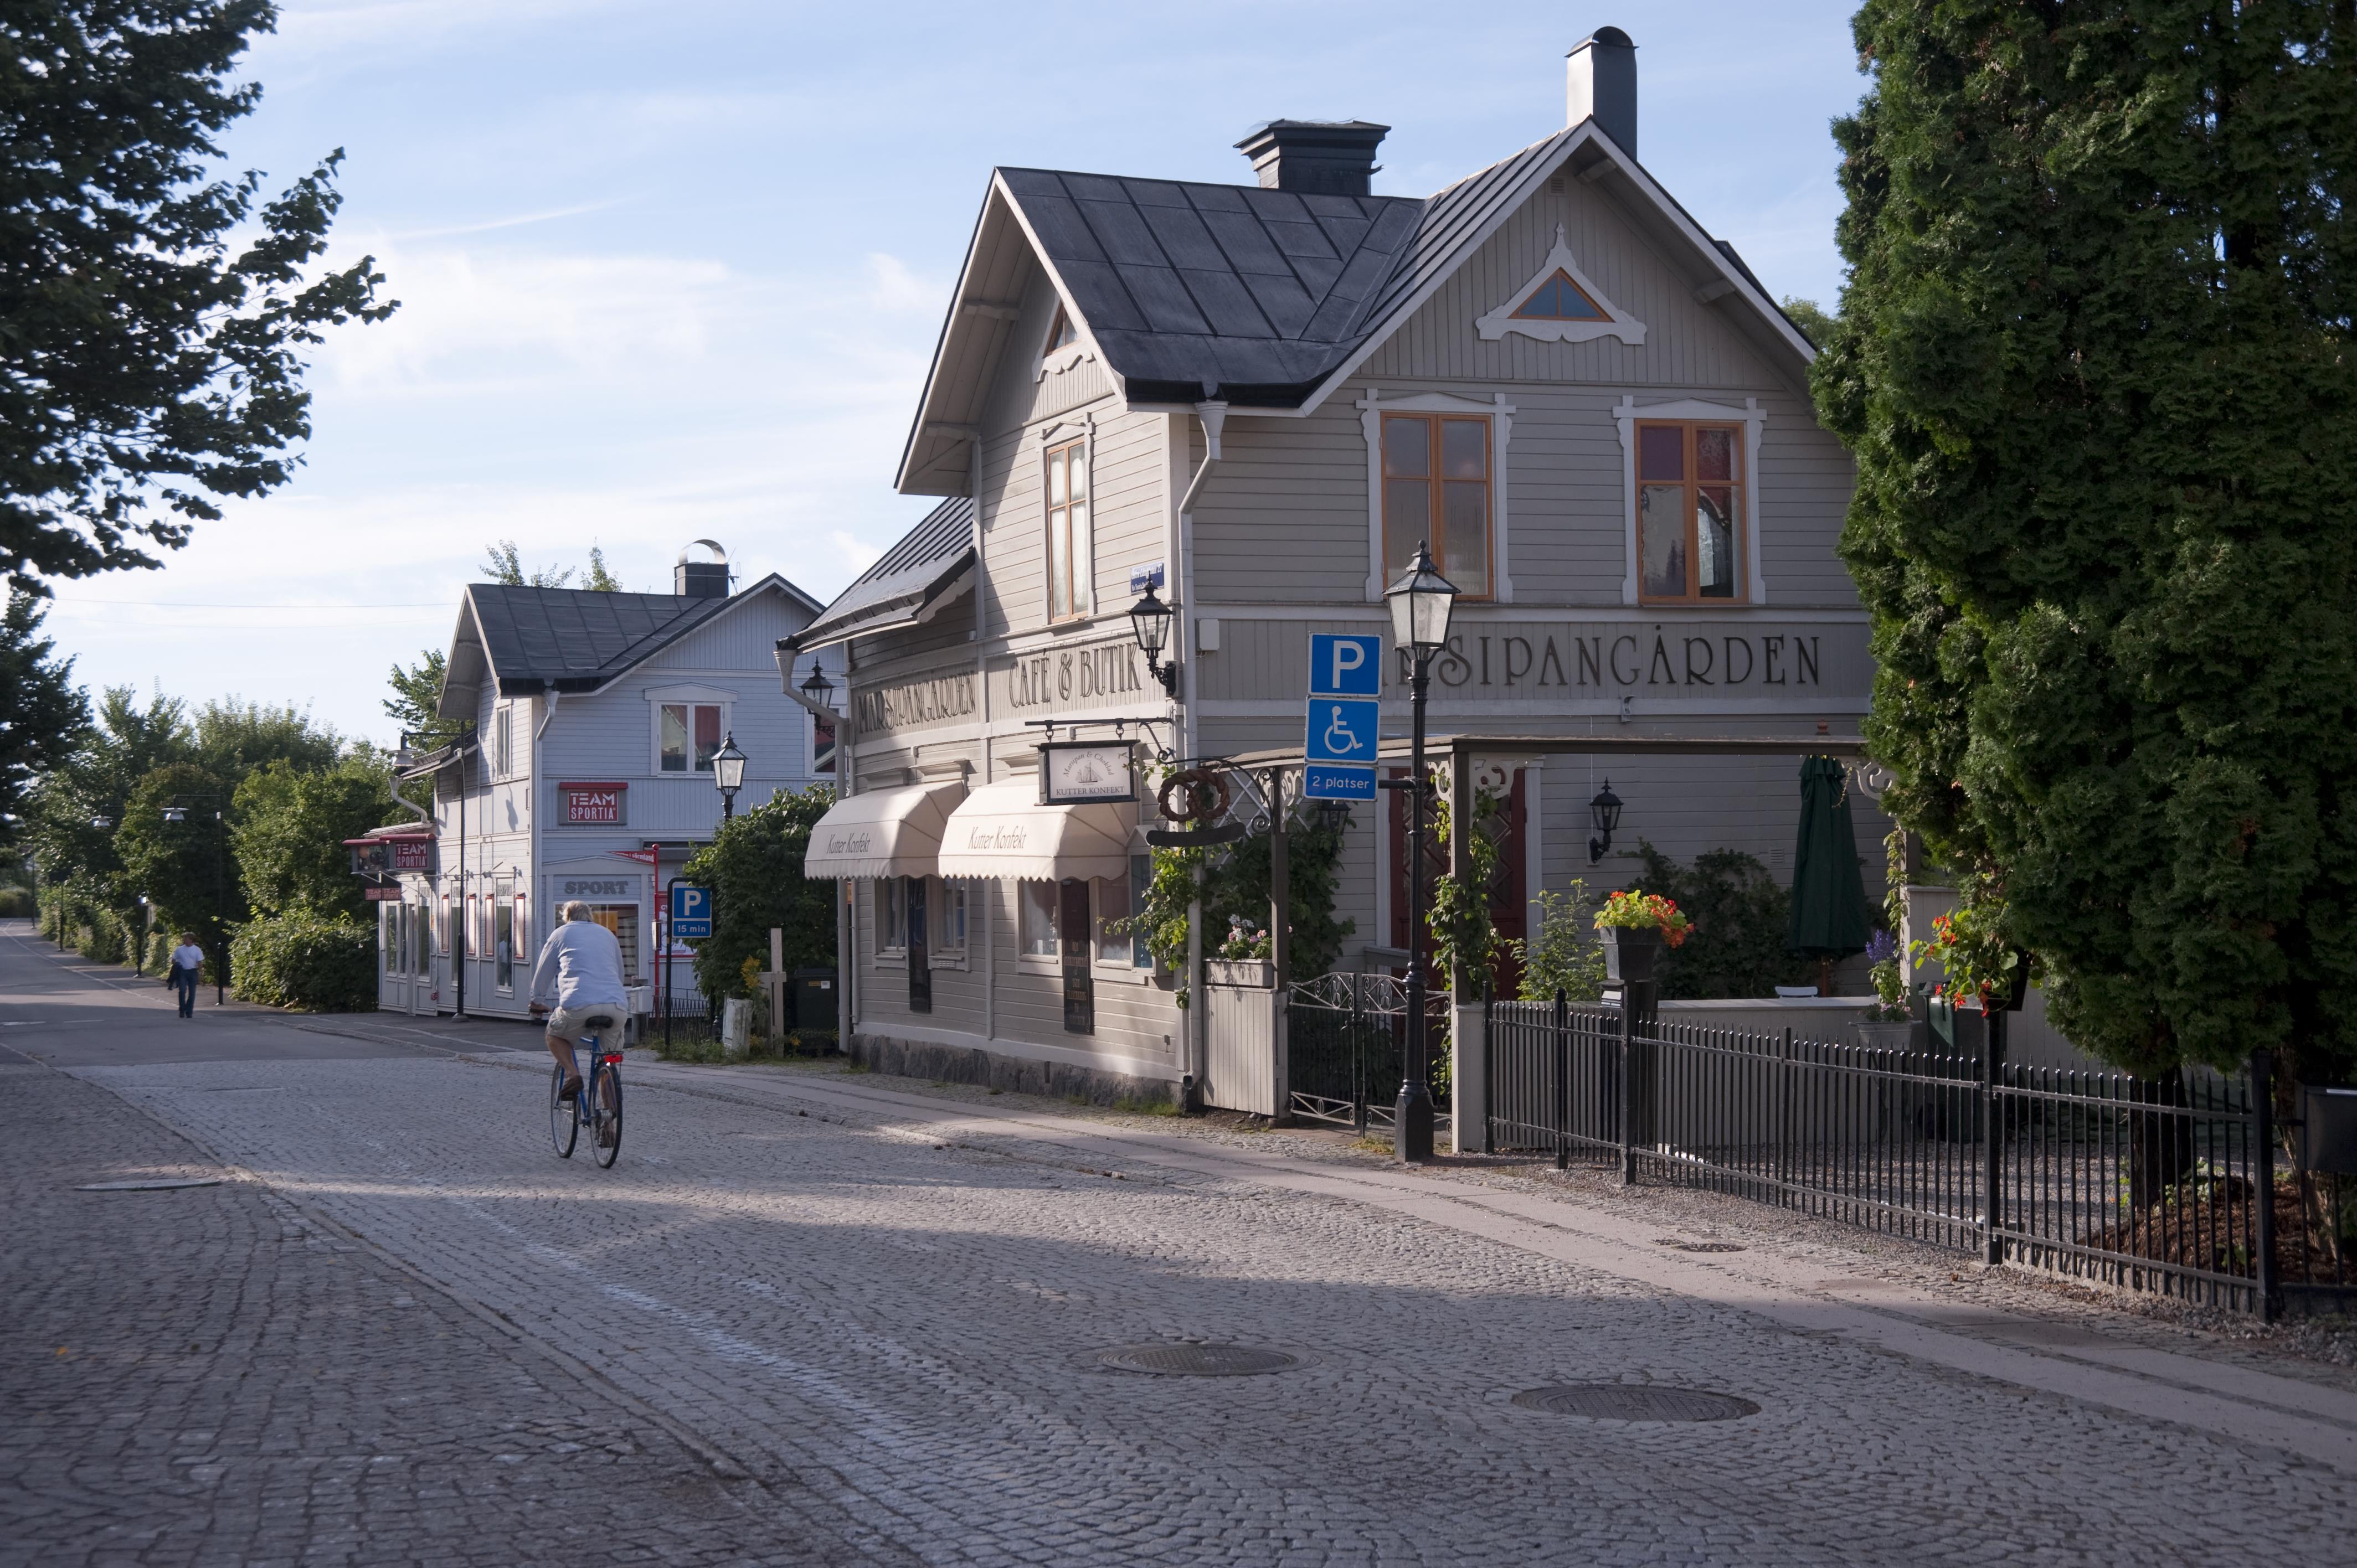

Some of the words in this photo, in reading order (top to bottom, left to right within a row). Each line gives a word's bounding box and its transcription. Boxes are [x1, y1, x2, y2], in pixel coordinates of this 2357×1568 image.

[1332, 640, 1365, 689] P
[1382, 624, 1819, 687] SIPANGÅRDEN
[1009, 648, 1050, 708] CAFÉ
[1058, 653, 1073, 701] &
[1080, 642, 1143, 698] BUTIK
[858, 669, 976, 734] MARSIPANGÅRDEN
[1063, 754, 1084, 777] Marsipan
[1094, 753, 1114, 775] Choklad
[1313, 776, 1320, 786] 2
[1326, 777, 1369, 789] platser
[570, 793, 615, 805] TEAM
[571, 807, 614, 819] SPORTIA
[827, 834, 846, 854] Kutter
[846, 832, 871, 853] Konfekt
[968, 827, 994, 849] Kutter
[994, 826, 1026, 849] Konfekt
[396, 844, 426, 854] TEAM
[397, 856, 426, 866] SPORTIA
[565, 880, 629, 894] SPORT
[684, 890, 701, 916] P
